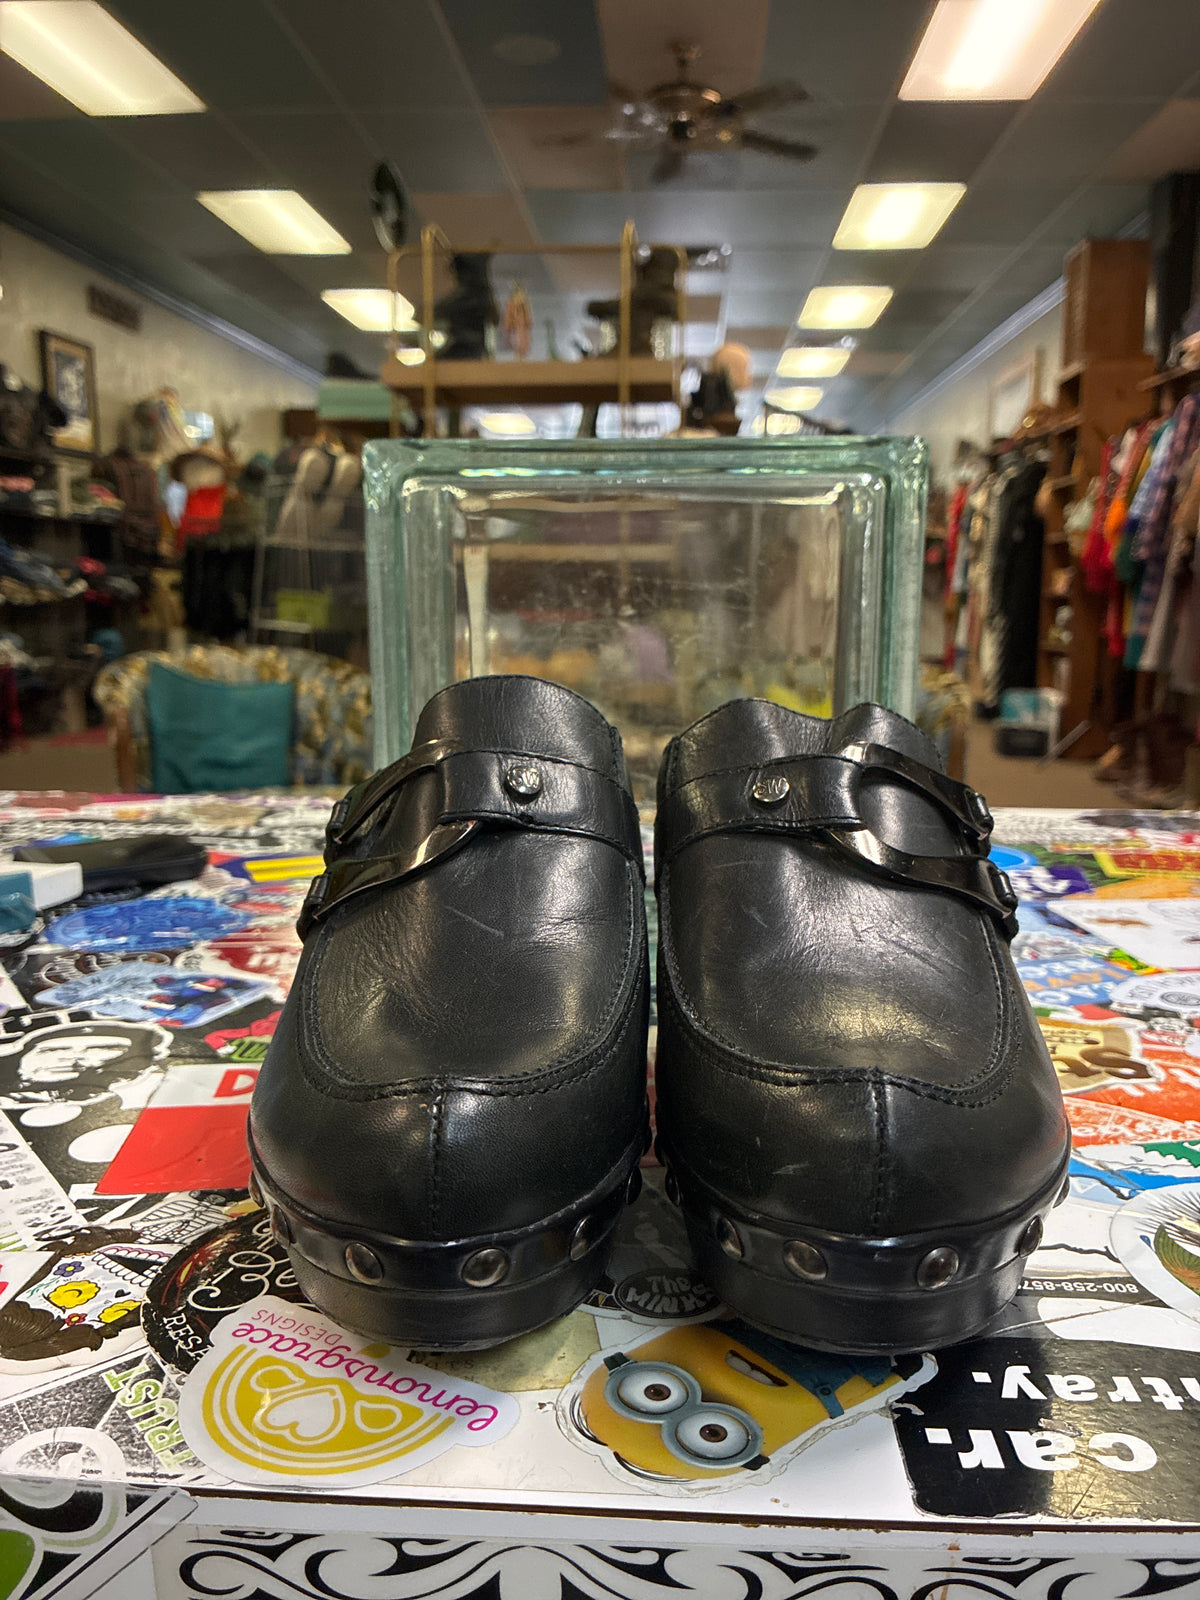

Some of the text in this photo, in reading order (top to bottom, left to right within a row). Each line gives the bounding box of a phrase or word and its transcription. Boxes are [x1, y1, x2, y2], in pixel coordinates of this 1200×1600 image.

[1017, 1277, 1140, 1295] 800-258-857
[249, 1308, 343, 1346] DESIGNS
[231, 1323, 498, 1432] lemonsgrace
[972, 1365, 1200, 1411] tray.
[925, 1427, 1158, 1472] car.
